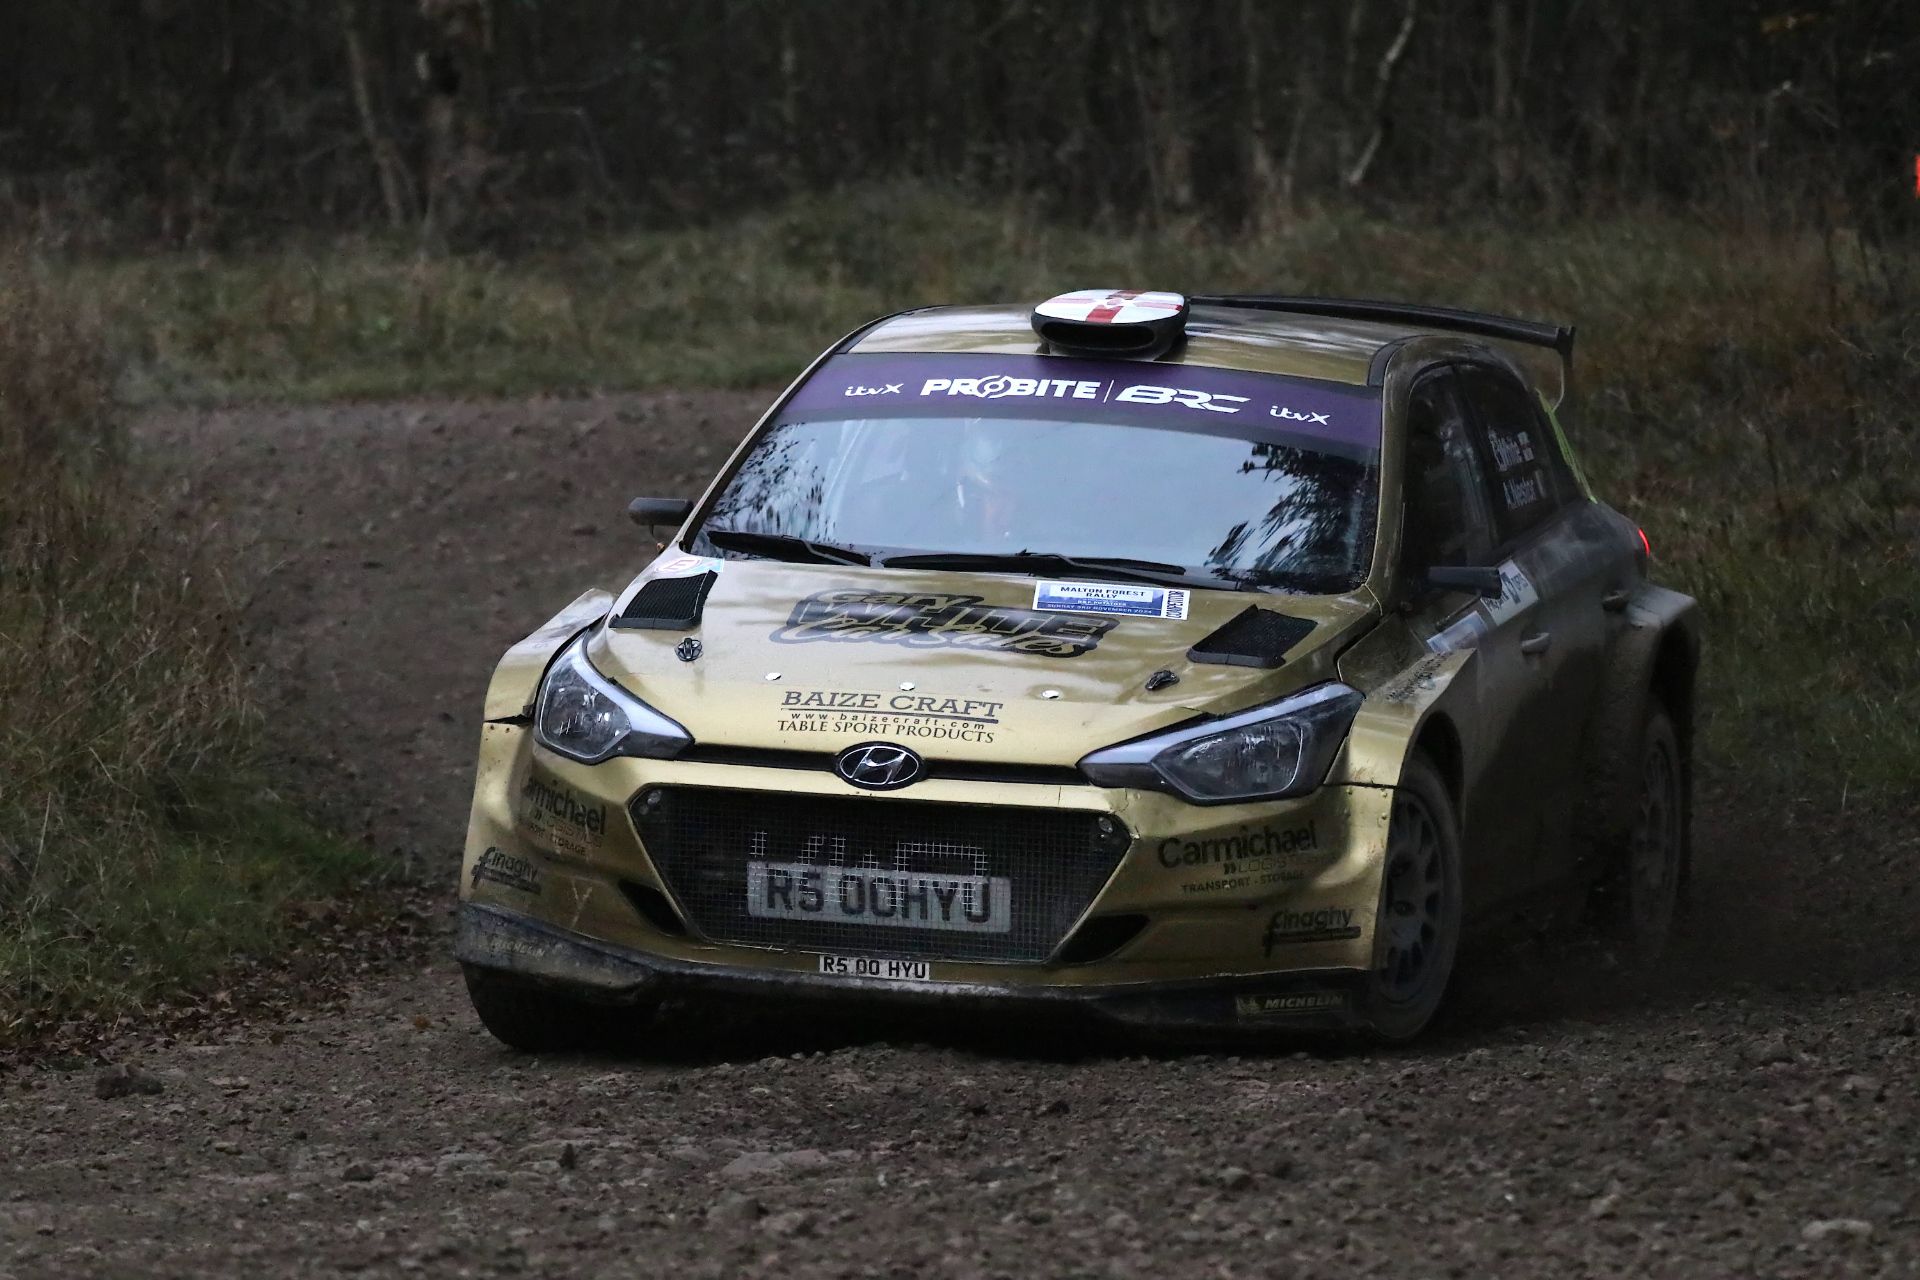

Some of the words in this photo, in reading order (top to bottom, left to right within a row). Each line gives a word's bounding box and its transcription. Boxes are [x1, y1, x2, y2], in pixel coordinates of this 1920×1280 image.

[844, 383, 904, 397] itvX
[920, 375, 1101, 400] PROBITE
[1115, 385, 1251, 413] BRC
[1269, 405, 1330, 425] itvX
[1060, 586, 1103, 594] MALTON
[1105, 589, 1146, 597] FOREST
[797, 601, 1110, 643] WHITE
[781, 691, 881, 709] BAIZE
[889, 696, 1003, 717] CRAFT
[777, 720, 828, 732] TABLE
[833, 721, 891, 735] SPORT
[895, 726, 995, 743] PRODUCTS
[791, 713, 985, 730] www.baizecraft.com
[1158, 820, 1318, 868] Carmichael
[1181, 877, 1251, 894] TRANSPORT
[822, 955, 848, 973] R5
[888, 960, 927, 979] HYU
